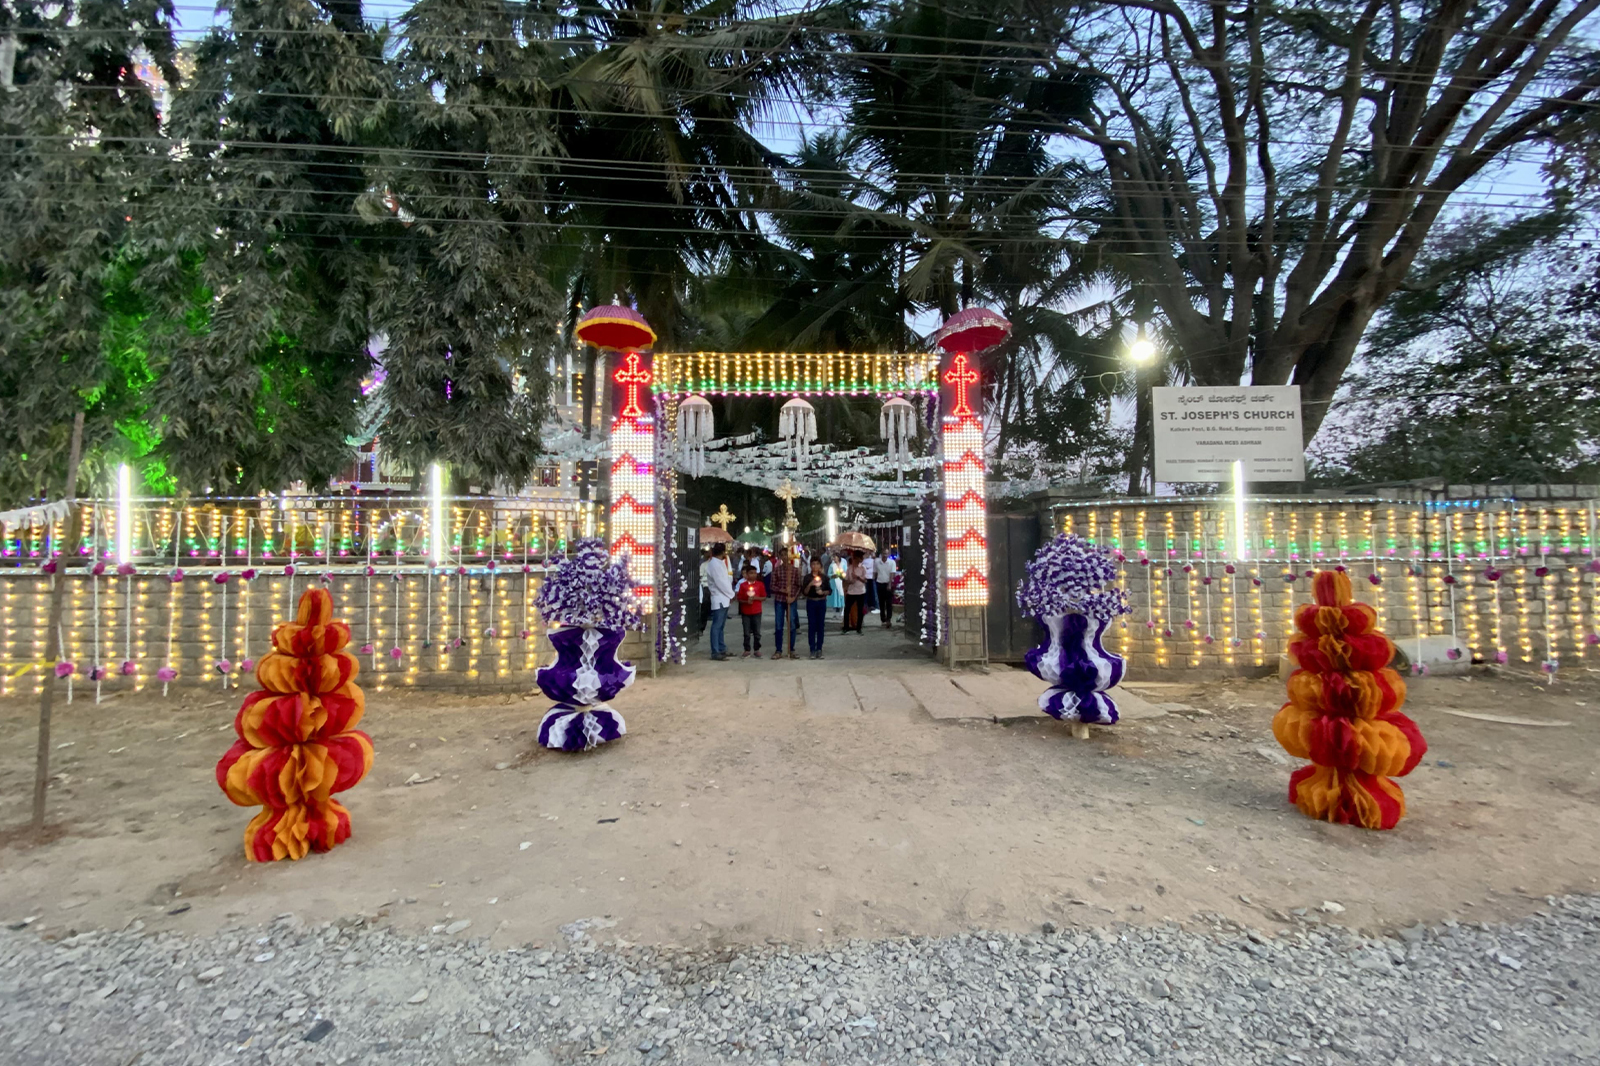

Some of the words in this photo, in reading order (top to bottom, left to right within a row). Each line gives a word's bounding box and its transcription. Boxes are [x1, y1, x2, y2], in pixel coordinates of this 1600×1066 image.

[1160, 411, 1178, 420] ST.
[1181, 410, 1240, 420] JOSEPH'S
[1243, 410, 1295, 420] CHURCH
